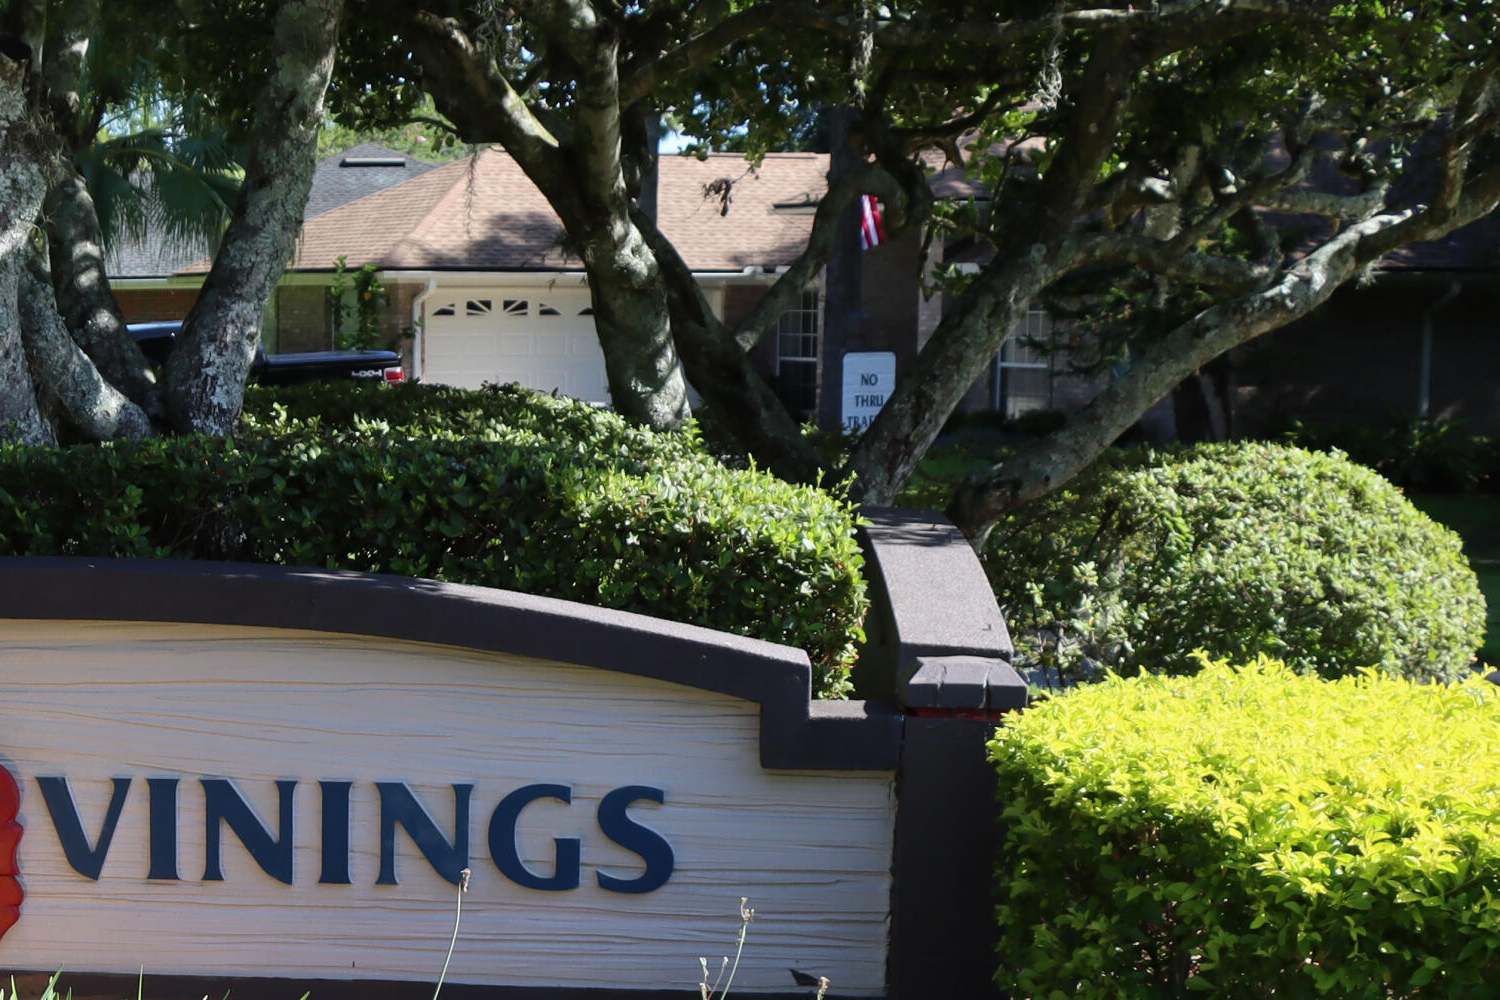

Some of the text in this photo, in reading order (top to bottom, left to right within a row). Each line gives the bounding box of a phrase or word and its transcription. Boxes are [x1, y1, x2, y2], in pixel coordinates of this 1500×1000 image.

[860, 373, 878, 386] NO
[854, 394, 884, 407] THRU
[846, 415, 876, 429] TRAF
[35, 775, 674, 894] VININGS
